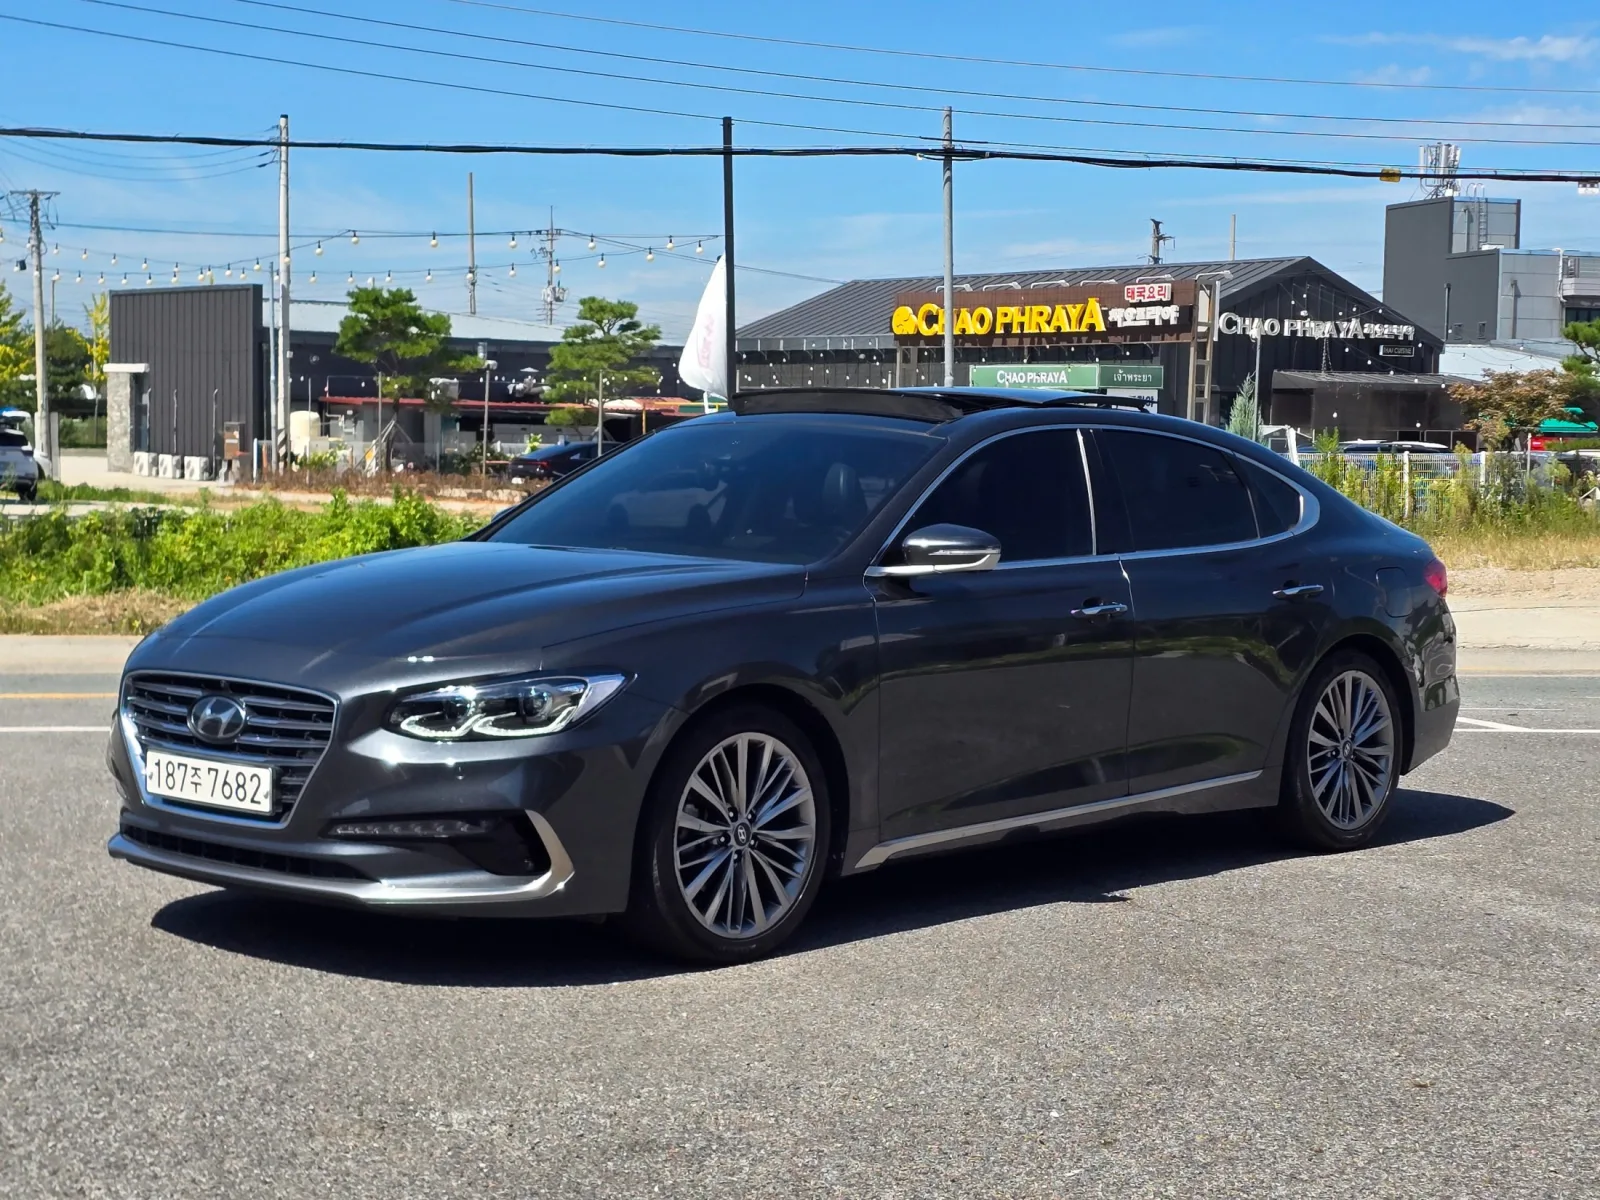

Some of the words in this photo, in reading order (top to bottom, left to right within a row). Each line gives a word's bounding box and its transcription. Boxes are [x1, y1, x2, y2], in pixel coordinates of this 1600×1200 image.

[1125, 284, 1168, 301] 태국요리
[917, 303, 993, 336] CHAO
[995, 297, 1107, 334] PHRAYA
[1219, 312, 1280, 336] CHAO
[1283, 318, 1365, 339] PHRAYA
[997, 370, 1025, 384] CHAO
[1027, 370, 1068, 384] PHRAYA
[1113, 368, 1152, 382] เจ้าพระยา
[154, 759, 202, 794] 187주
[207, 767, 261, 804] 7682
